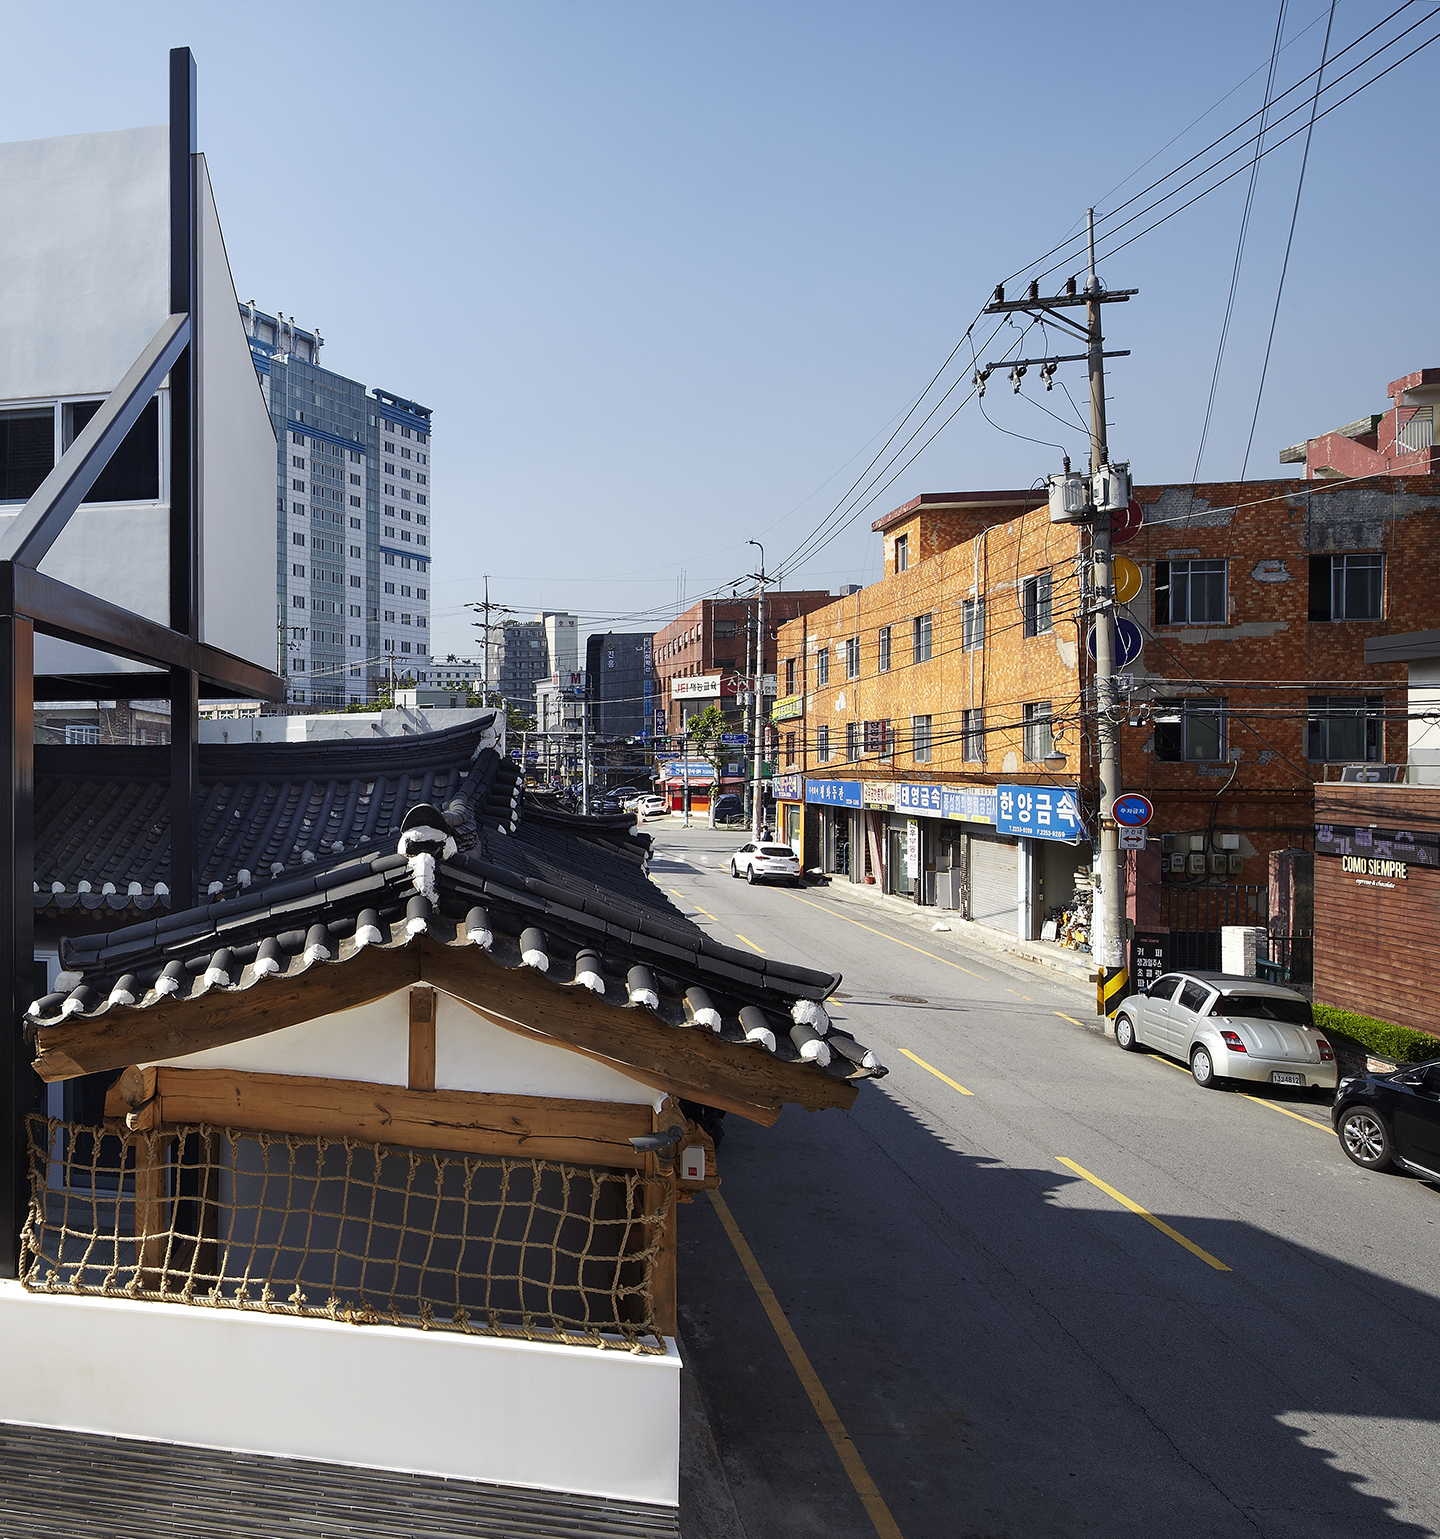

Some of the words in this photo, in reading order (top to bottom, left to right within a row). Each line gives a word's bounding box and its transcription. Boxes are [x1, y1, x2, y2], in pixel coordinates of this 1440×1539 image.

[675, 683, 689, 693] JEI
[901, 786, 940, 809] 태영금속
[1000, 791, 1075, 827] 한양금속
[1342, 855, 1367, 874] COMO
[1368, 858, 1407, 879] SIEMPRE
